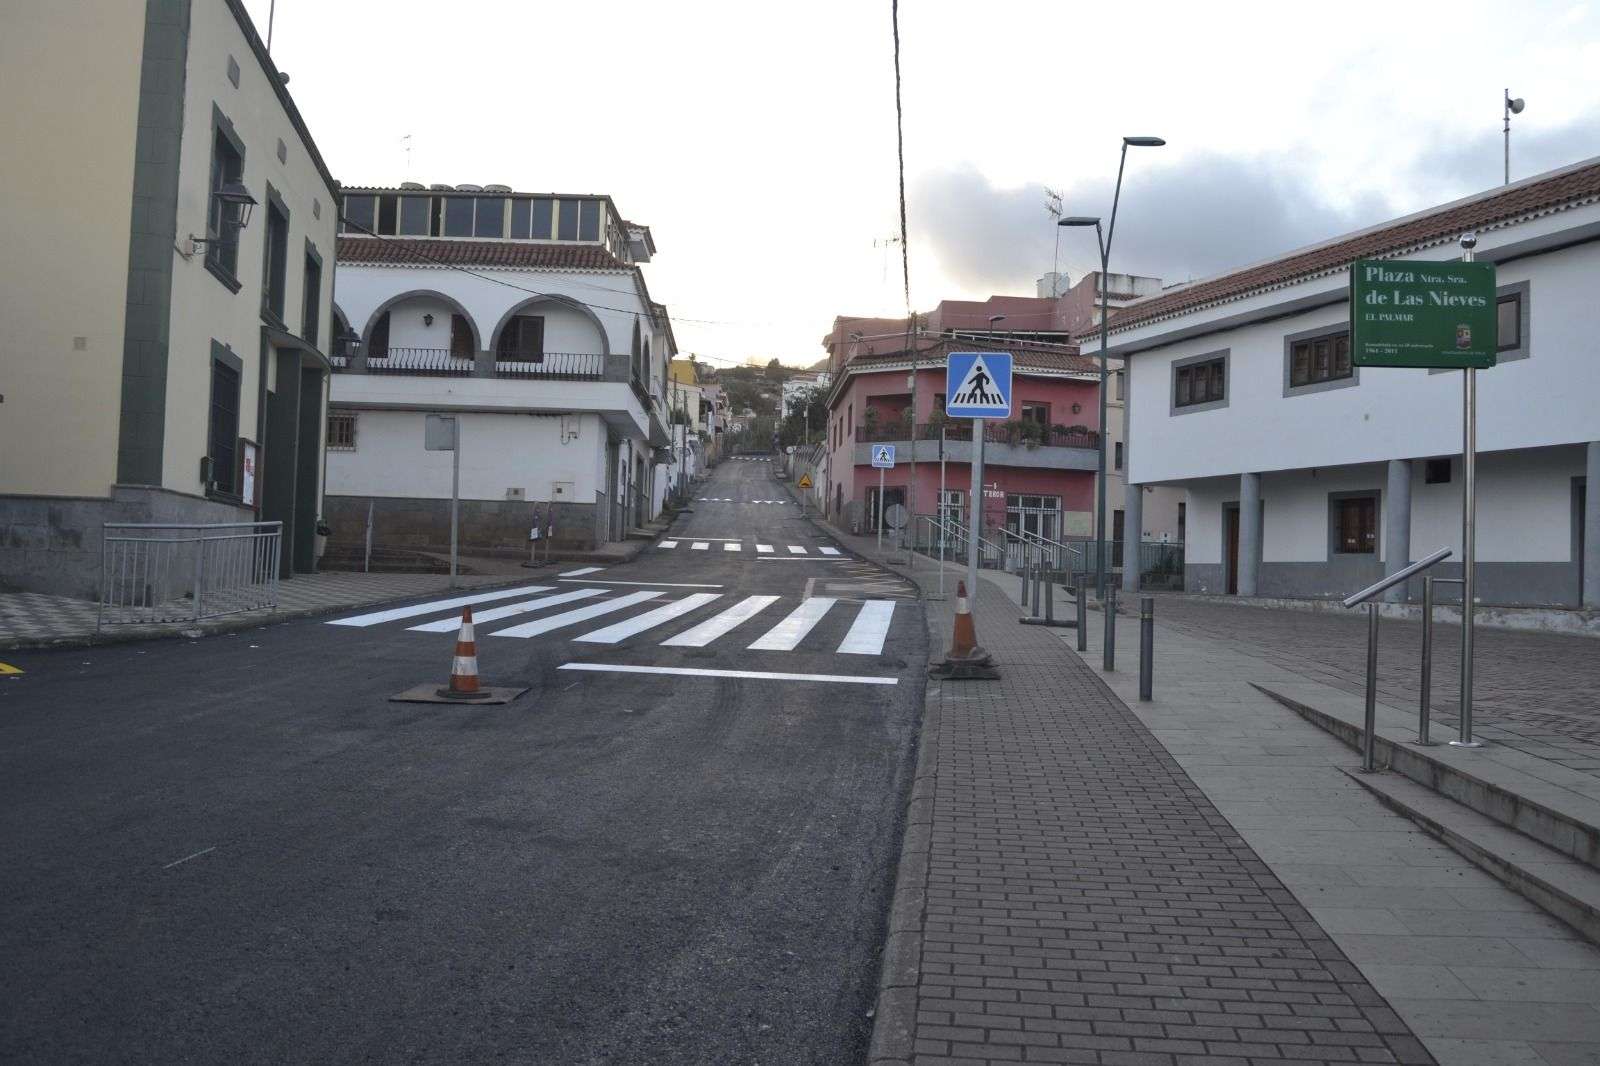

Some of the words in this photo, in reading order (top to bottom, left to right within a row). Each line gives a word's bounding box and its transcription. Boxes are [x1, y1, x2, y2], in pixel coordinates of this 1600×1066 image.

[1366, 267, 1414, 282] Plaza
[1420, 274, 1445, 283] Ntra.
[1447, 274, 1467, 284] Sra.
[1366, 290, 1388, 305] de
[1393, 290, 1424, 306] Las
[1429, 291, 1487, 307] Nieves
[1366, 313, 1376, 321] EL
[1379, 313, 1414, 321] PALMAR
